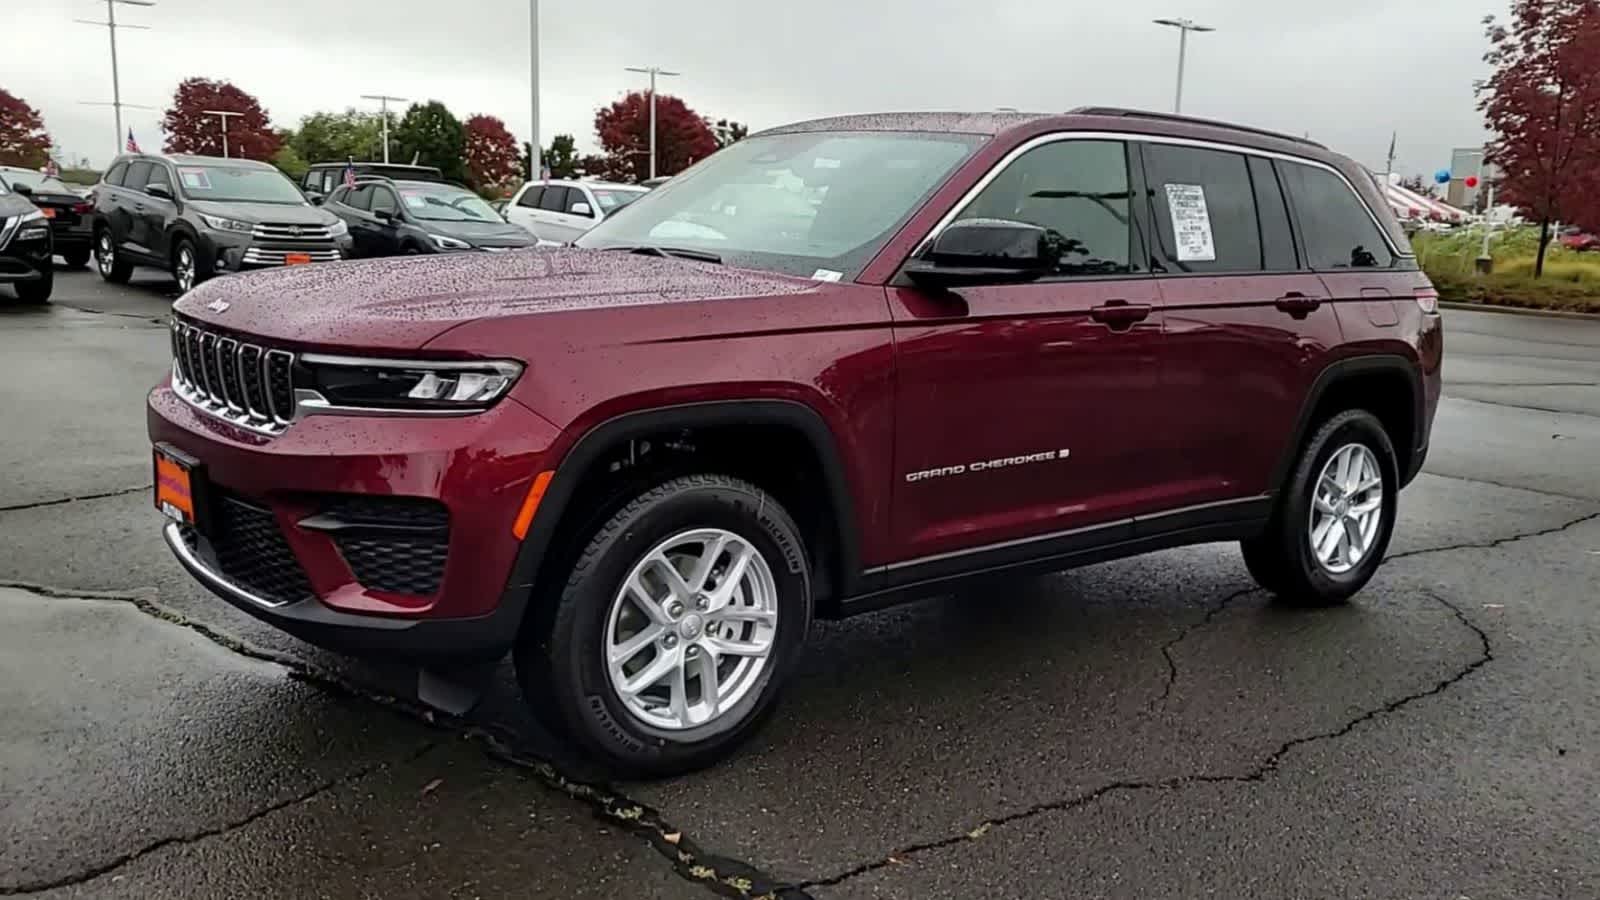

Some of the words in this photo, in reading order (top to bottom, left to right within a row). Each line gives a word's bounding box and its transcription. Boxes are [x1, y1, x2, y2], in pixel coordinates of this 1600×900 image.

[905, 464, 966, 482] GRAND
[969, 450, 1056, 472] CHEROKEE
[760, 514, 801, 571] MICHELIN
